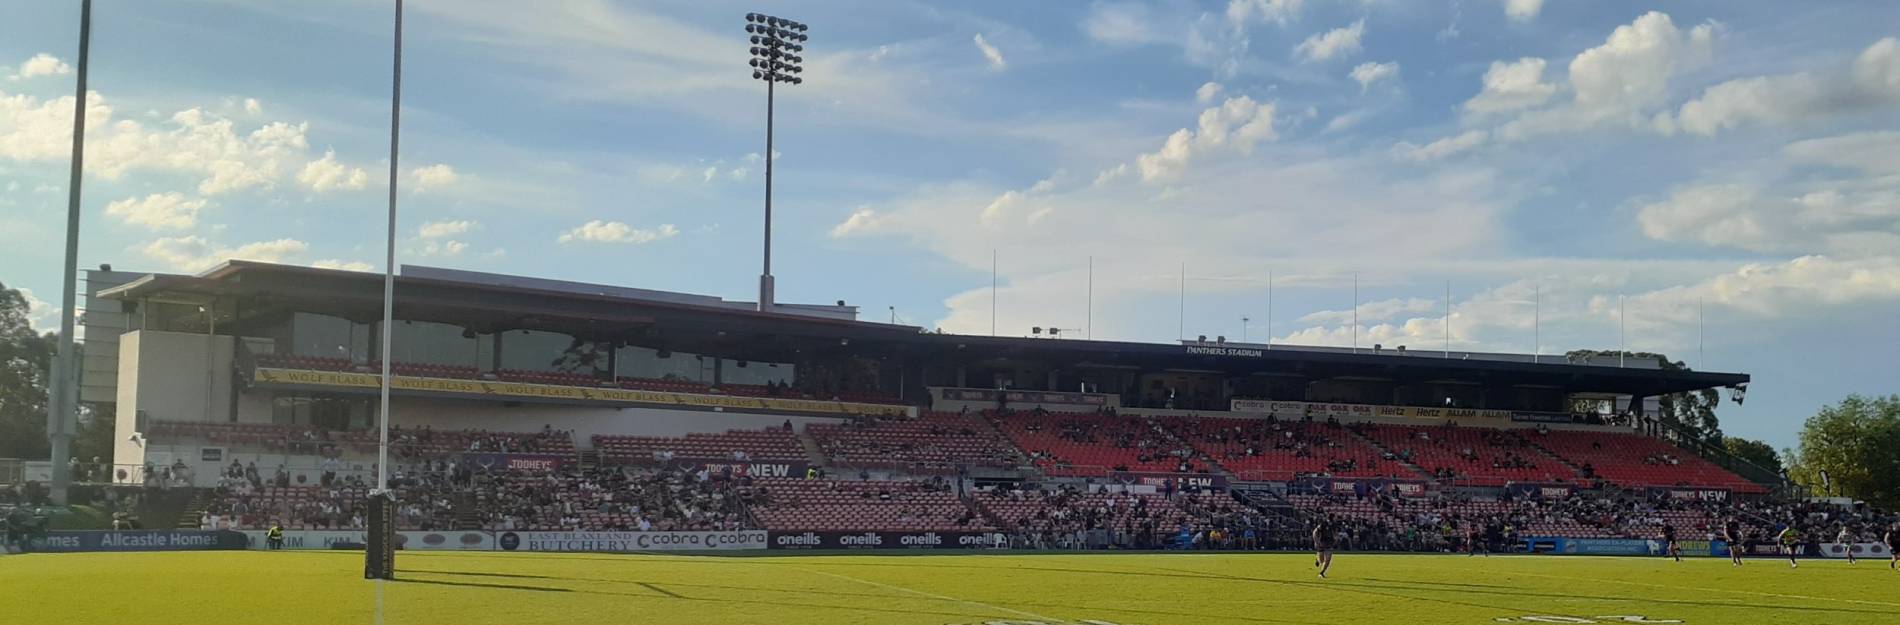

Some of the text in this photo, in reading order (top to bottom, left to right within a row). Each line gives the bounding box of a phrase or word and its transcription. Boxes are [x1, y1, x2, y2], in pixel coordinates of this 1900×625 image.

[1186, 346, 1262, 358] PANTHERS STADIUM
[288, 373, 365, 385] WOLF BLASS
[1380, 407, 1405, 416] Hertz
[1416, 408, 1440, 417] Hertz
[510, 459, 552, 471] TOOHEYS
[704, 463, 790, 477] TOOYS NEW
[101, 532, 218, 547] Allcastle Homes
[528, 532, 632, 541] EAST BLAXLAND
[652, 533, 699, 544] cobra
[720, 533, 765, 544] cobra
[777, 532, 821, 545] oneills
[839, 532, 882, 545] oneills
[900, 532, 942, 545] oneills
[528, 540, 631, 551] BUTCHERY
